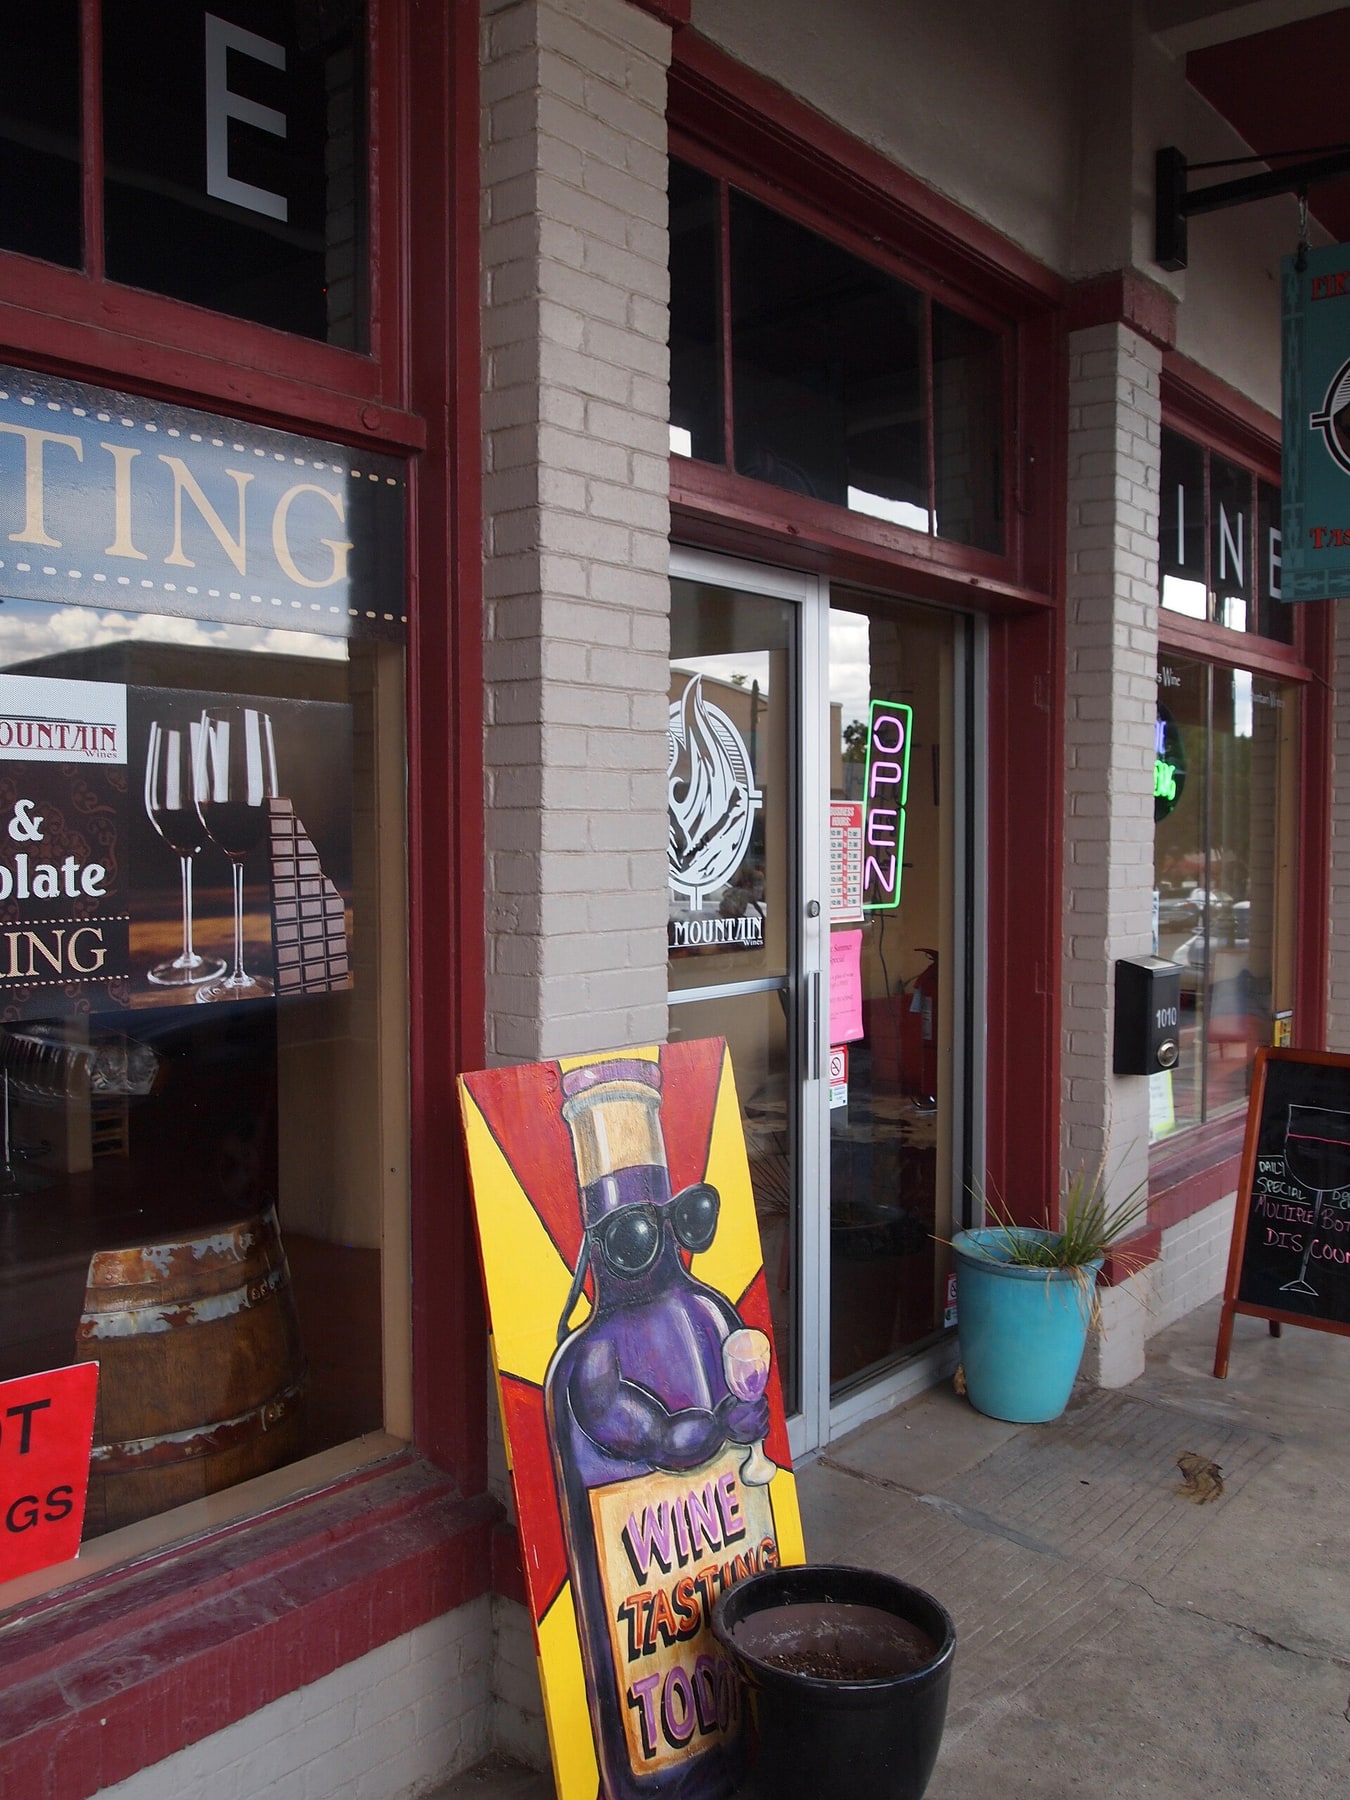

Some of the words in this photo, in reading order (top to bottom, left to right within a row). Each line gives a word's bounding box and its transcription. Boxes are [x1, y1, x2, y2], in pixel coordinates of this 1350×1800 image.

[205, 12, 288, 223] E
[0, 422, 354, 589] TING
[1162, 666, 1181, 687] Wine
[84, 748, 118, 759] Wines
[864, 714, 905, 893] OPEN
[9, 799, 44, 841] &
[674, 916, 763, 946] MOUNTAIN
[743, 939, 764, 947] Wines
[0, 927, 108, 978] ING
[1156, 1006, 1177, 1029] 1010
[1259, 1160, 1286, 1177] DAILY
[1256, 1176, 1308, 1201] SPECIAL
[1255, 1195, 1314, 1225] MULTIPLE
[0, 1398, 52, 1455] T
[622, 1471, 746, 1586] WINE
